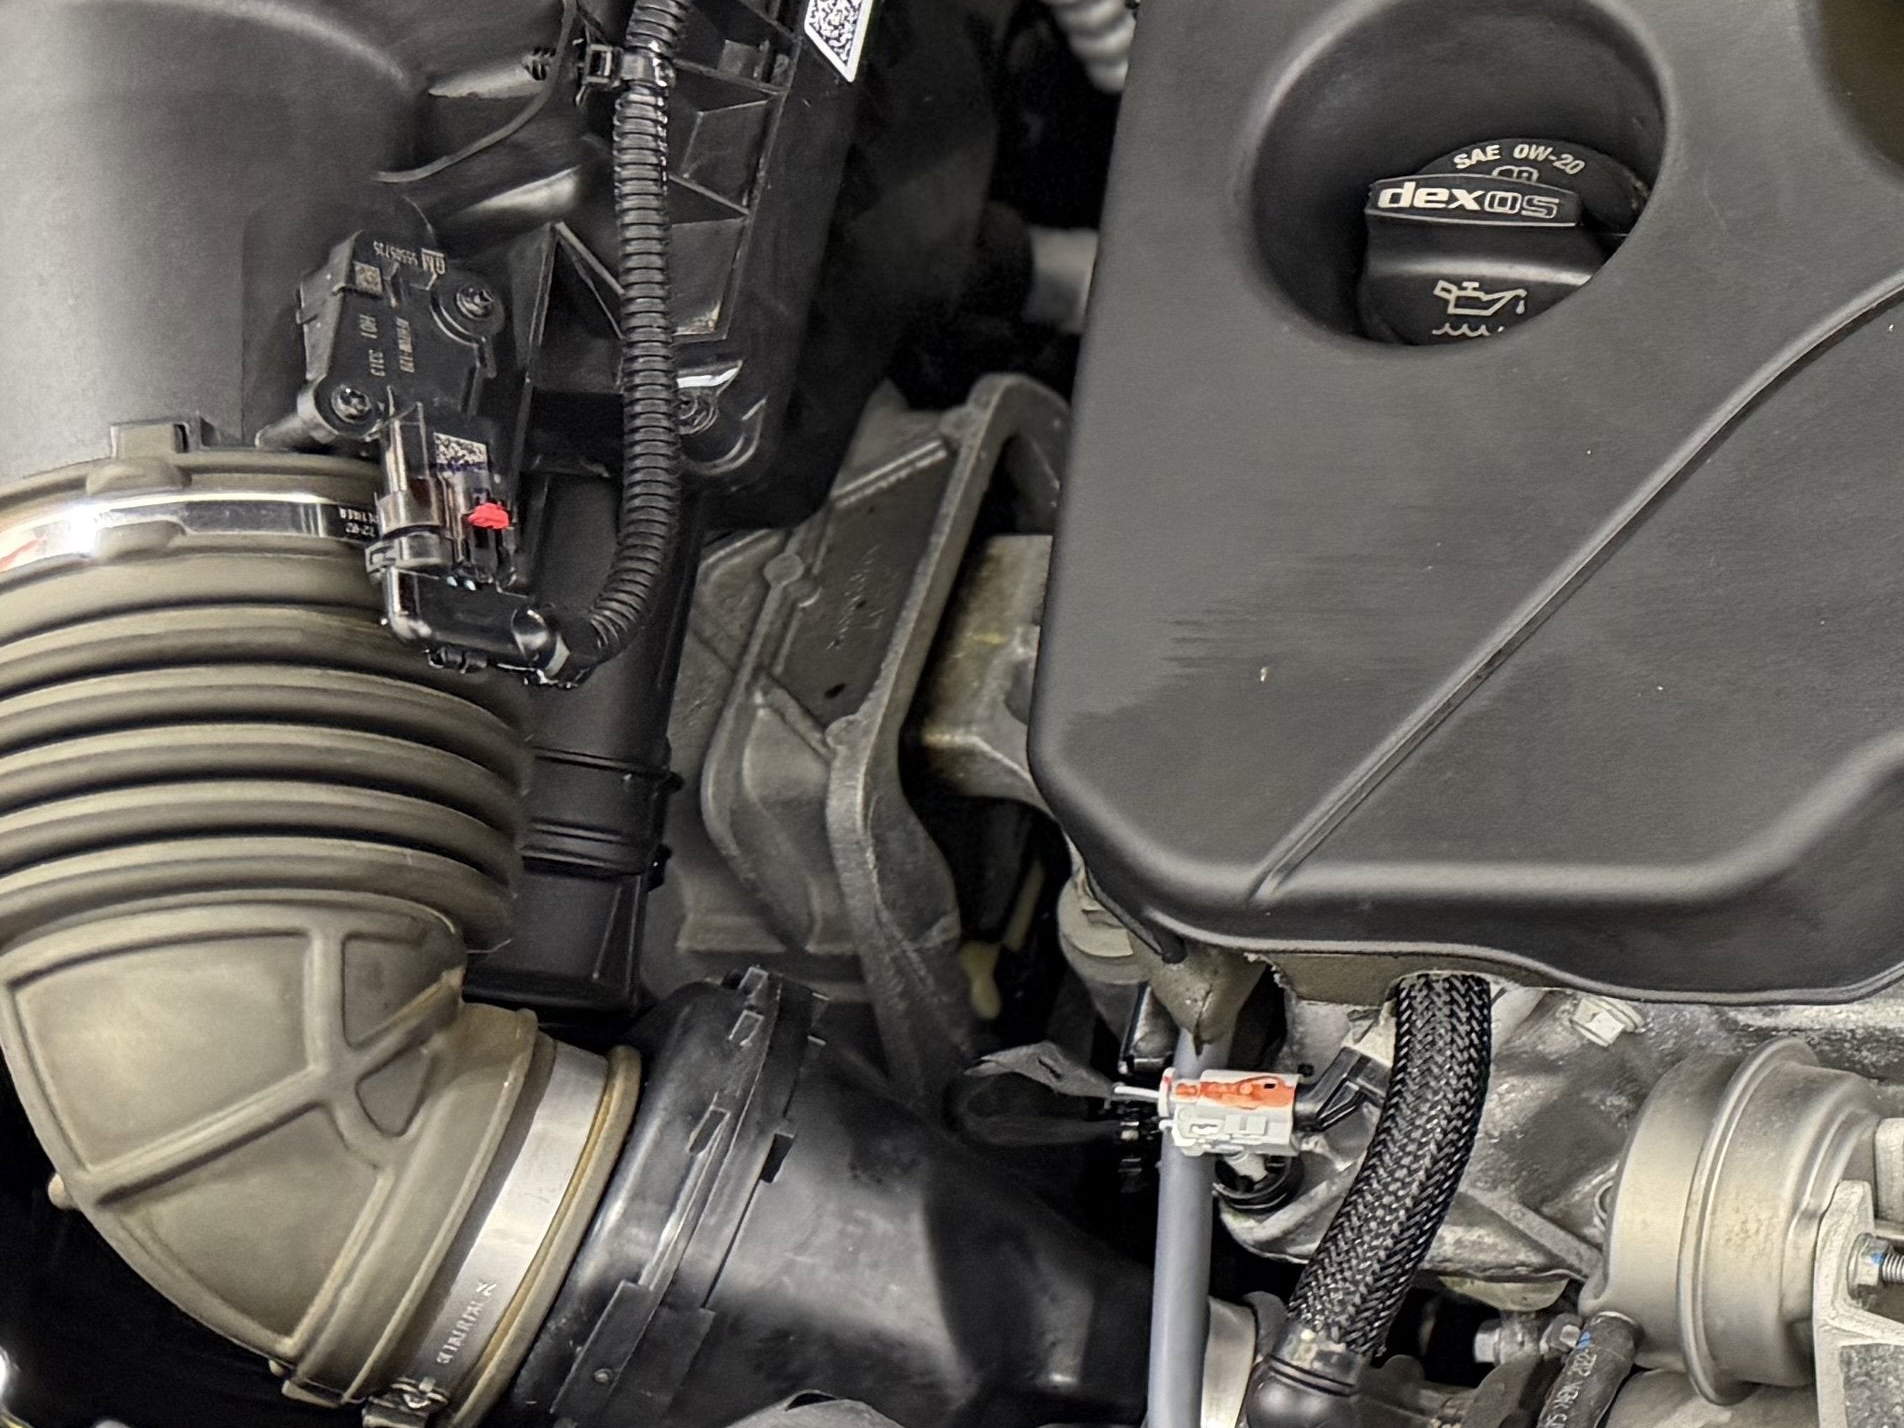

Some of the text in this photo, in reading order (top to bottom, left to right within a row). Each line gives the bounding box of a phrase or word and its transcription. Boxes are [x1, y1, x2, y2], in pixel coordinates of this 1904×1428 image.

[1453, 143, 1586, 175] SAE 0W-20
[1377, 181, 1560, 219] dexos
